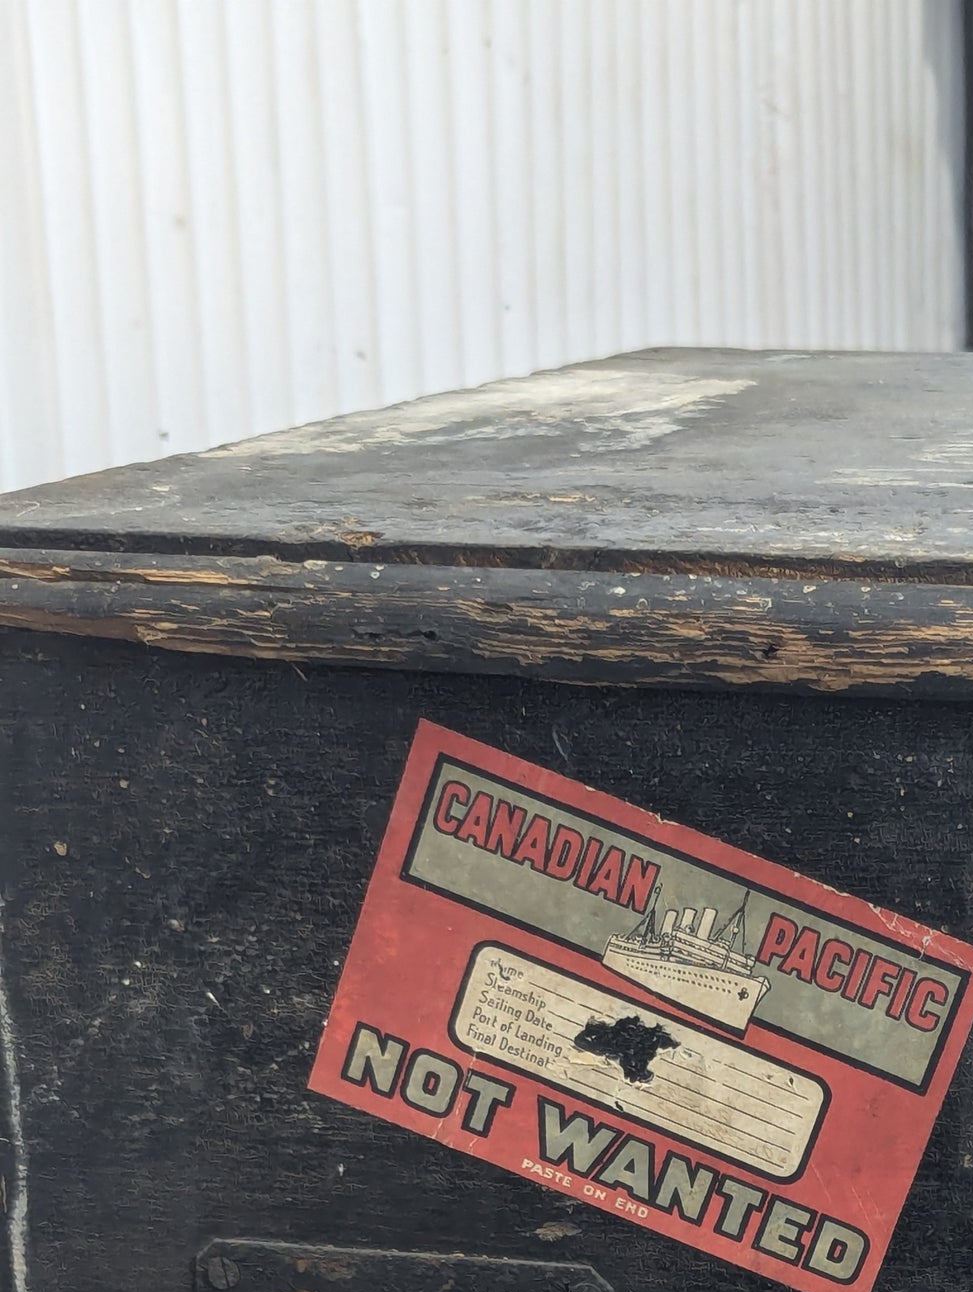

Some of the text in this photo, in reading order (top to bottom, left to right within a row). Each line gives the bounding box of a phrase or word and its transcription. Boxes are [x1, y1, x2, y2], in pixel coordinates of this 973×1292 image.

[434, 780, 949, 1034] CANADIAN PACIFIC
[478, 990, 554, 1032] Sailing Date
[485, 972, 547, 1011] Steamship
[466, 1023, 497, 1047] Final
[472, 1006, 563, 1058] Port of Landing
[342, 1021, 513, 1138] NOT
[536, 1094, 871, 1286] WANTED
[521, 1158, 649, 1219] PASTE ON END
